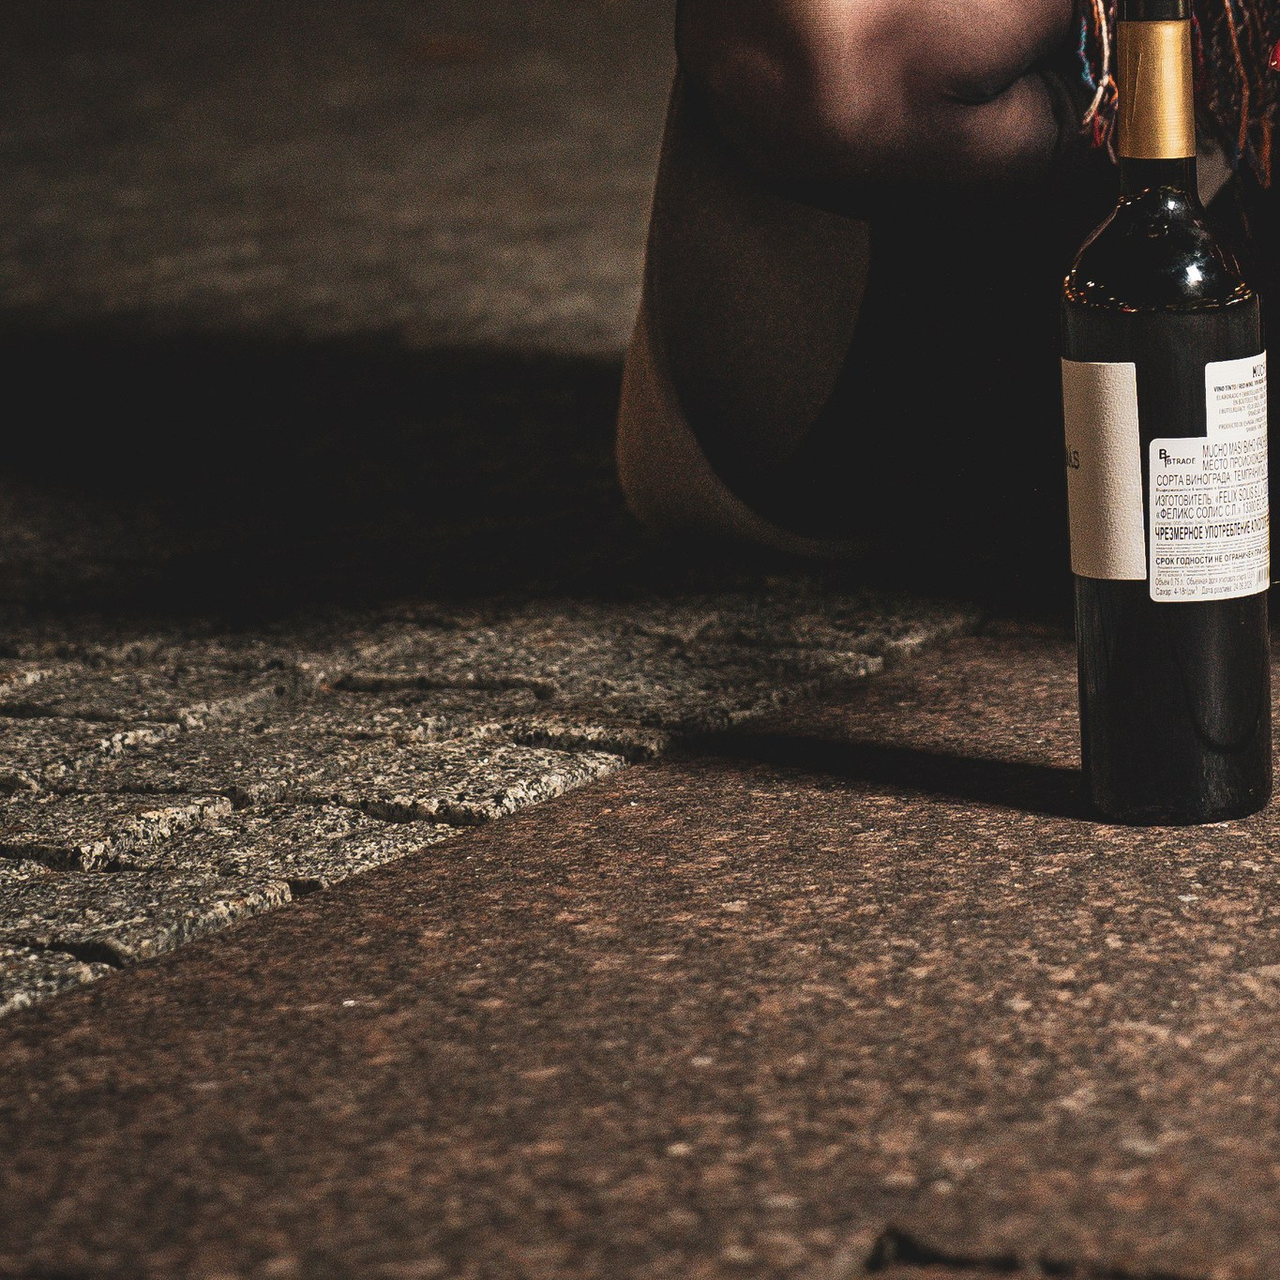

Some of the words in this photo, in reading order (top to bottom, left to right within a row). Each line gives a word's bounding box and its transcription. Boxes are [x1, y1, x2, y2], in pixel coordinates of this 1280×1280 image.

[1156, 474, 1184, 486] СОРТА
[1195, 505, 1224, 519] СОЛИС
[1154, 525, 1203, 540] ЧРЕЗМЕРНОЕ
[1155, 557, 1175, 565] СРОК
[1176, 556, 1214, 565] ГОДНОСТИ
[1215, 555, 1223, 563] НЕ
